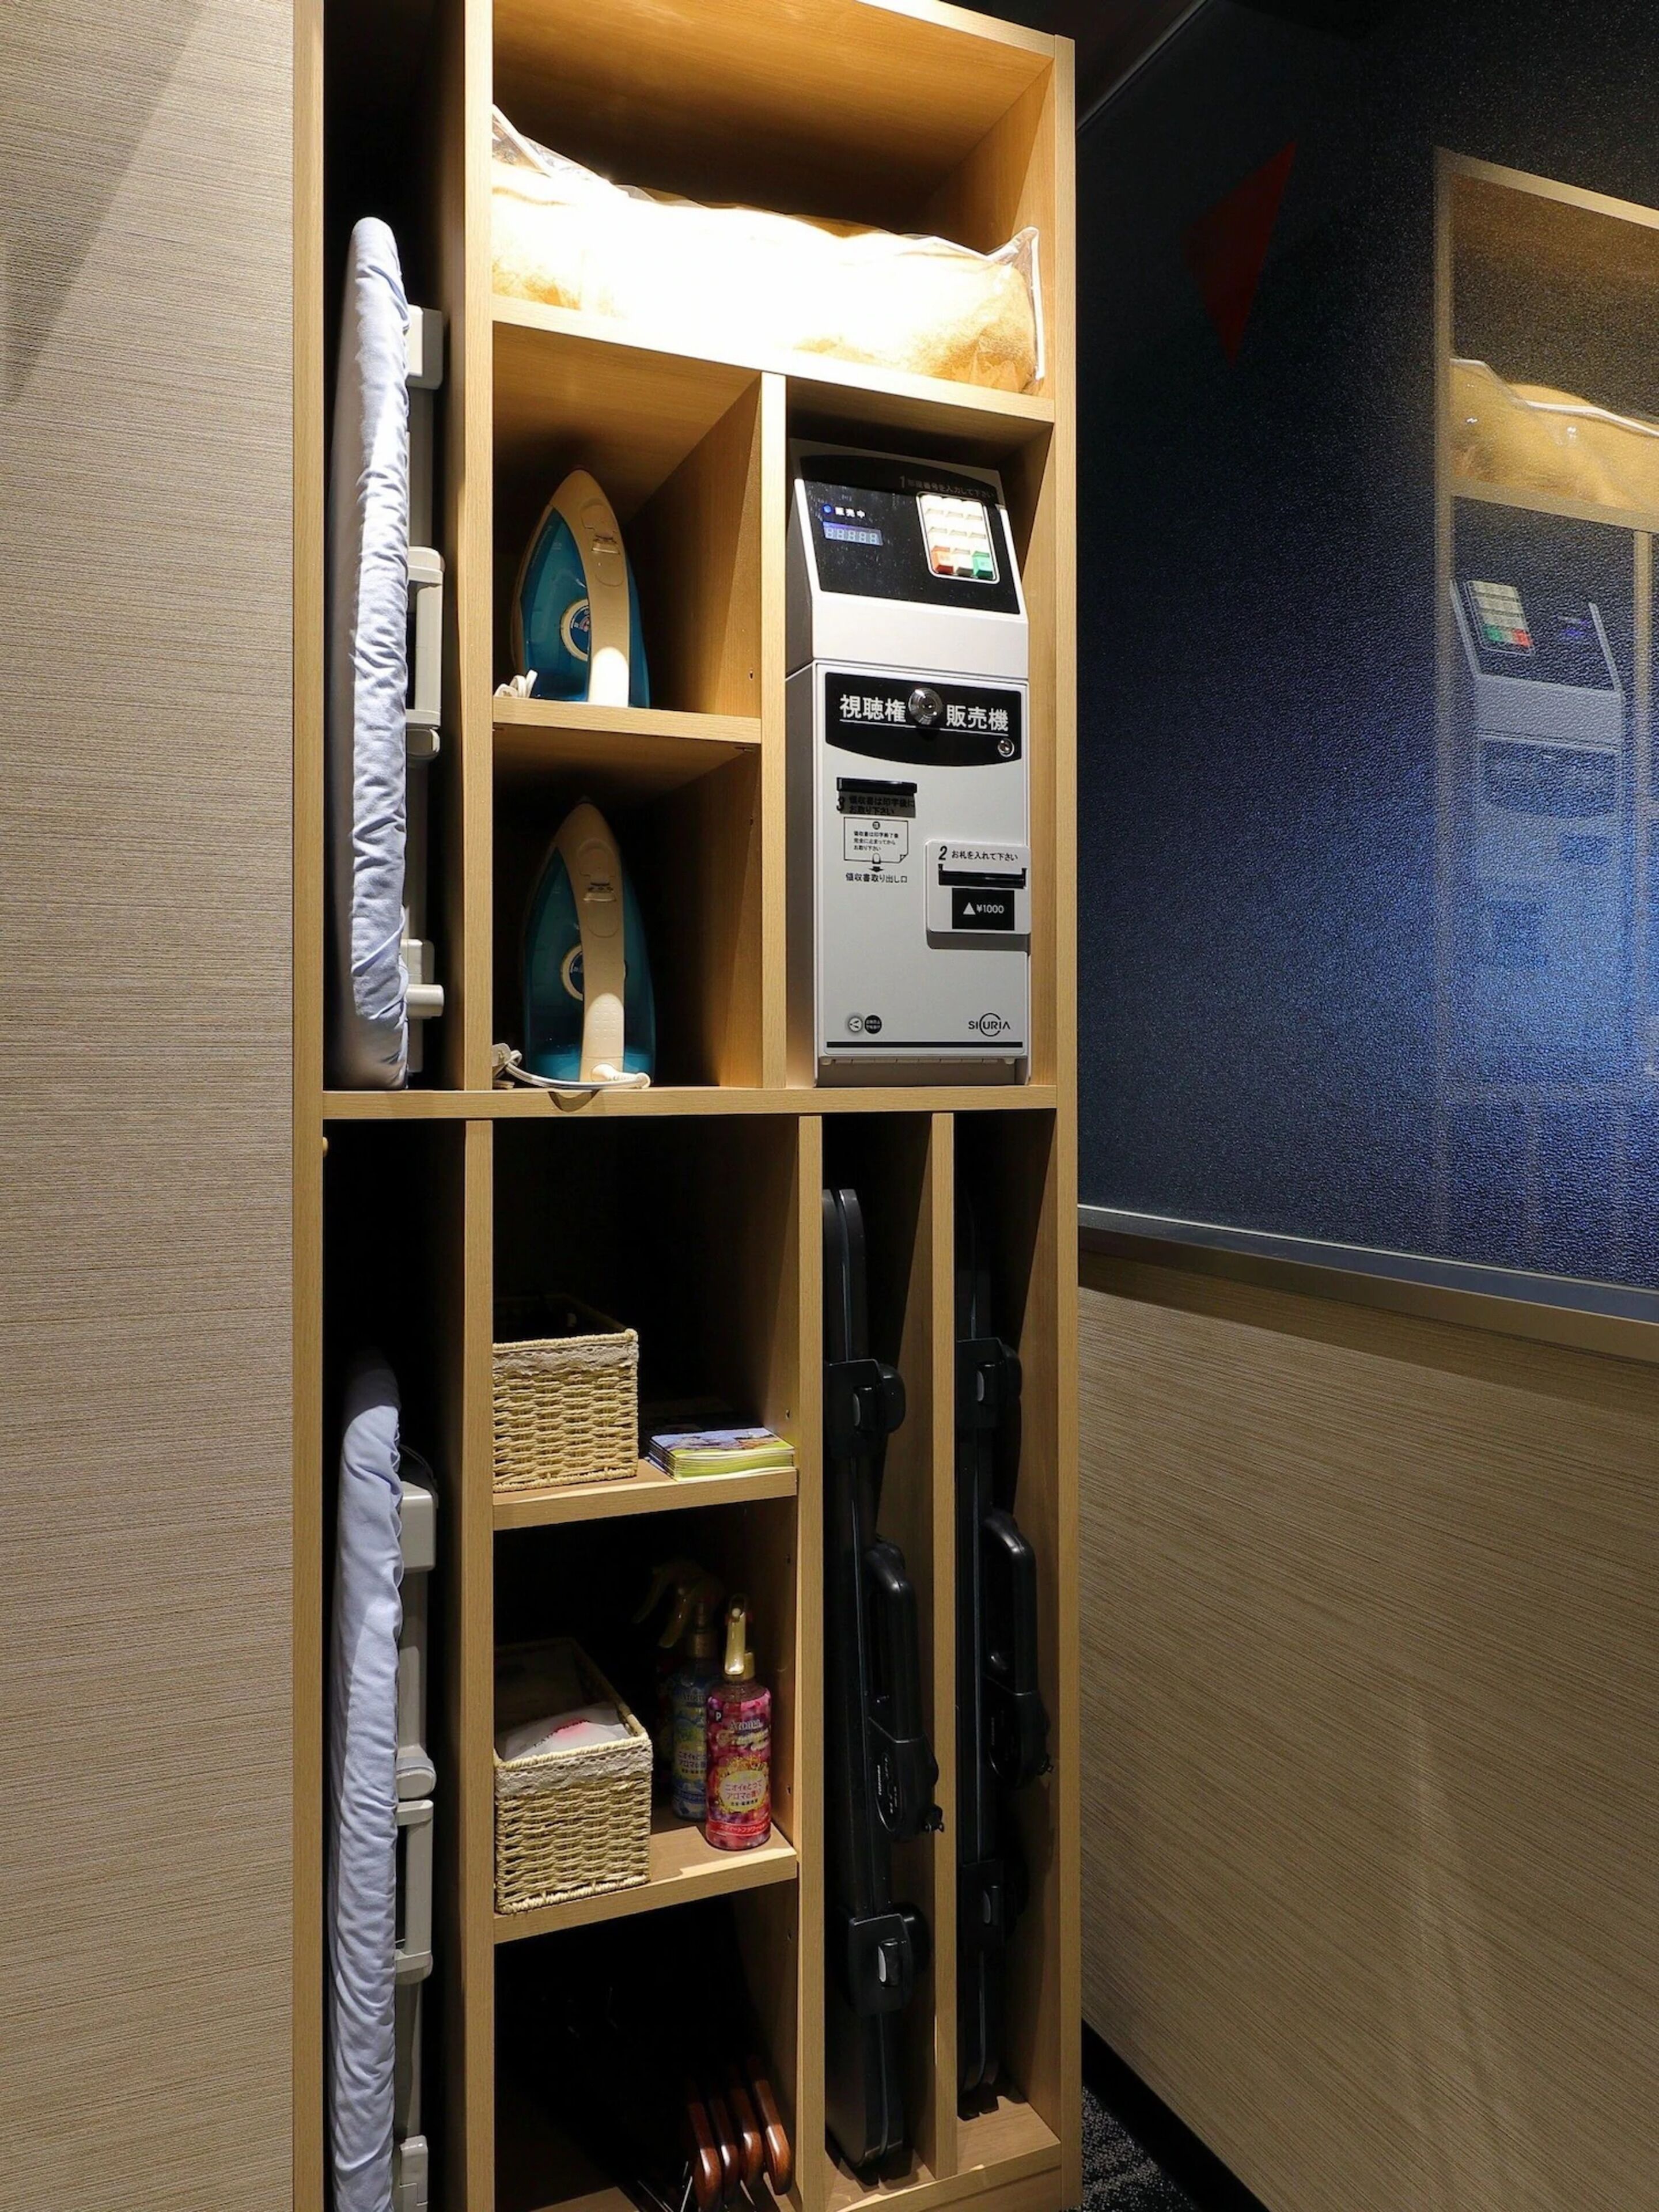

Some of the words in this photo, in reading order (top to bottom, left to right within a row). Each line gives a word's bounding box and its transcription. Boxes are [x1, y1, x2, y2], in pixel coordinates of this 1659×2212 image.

[839, 694, 907, 722] 視聴権
[945, 704, 1009, 732] 販売機
[938, 845, 948, 861] 2
[951, 850, 1018, 862] お札を入れて下さい
[845, 872, 908, 884] 領収書取り出し口
[976, 904, 1005, 914] ¥1000
